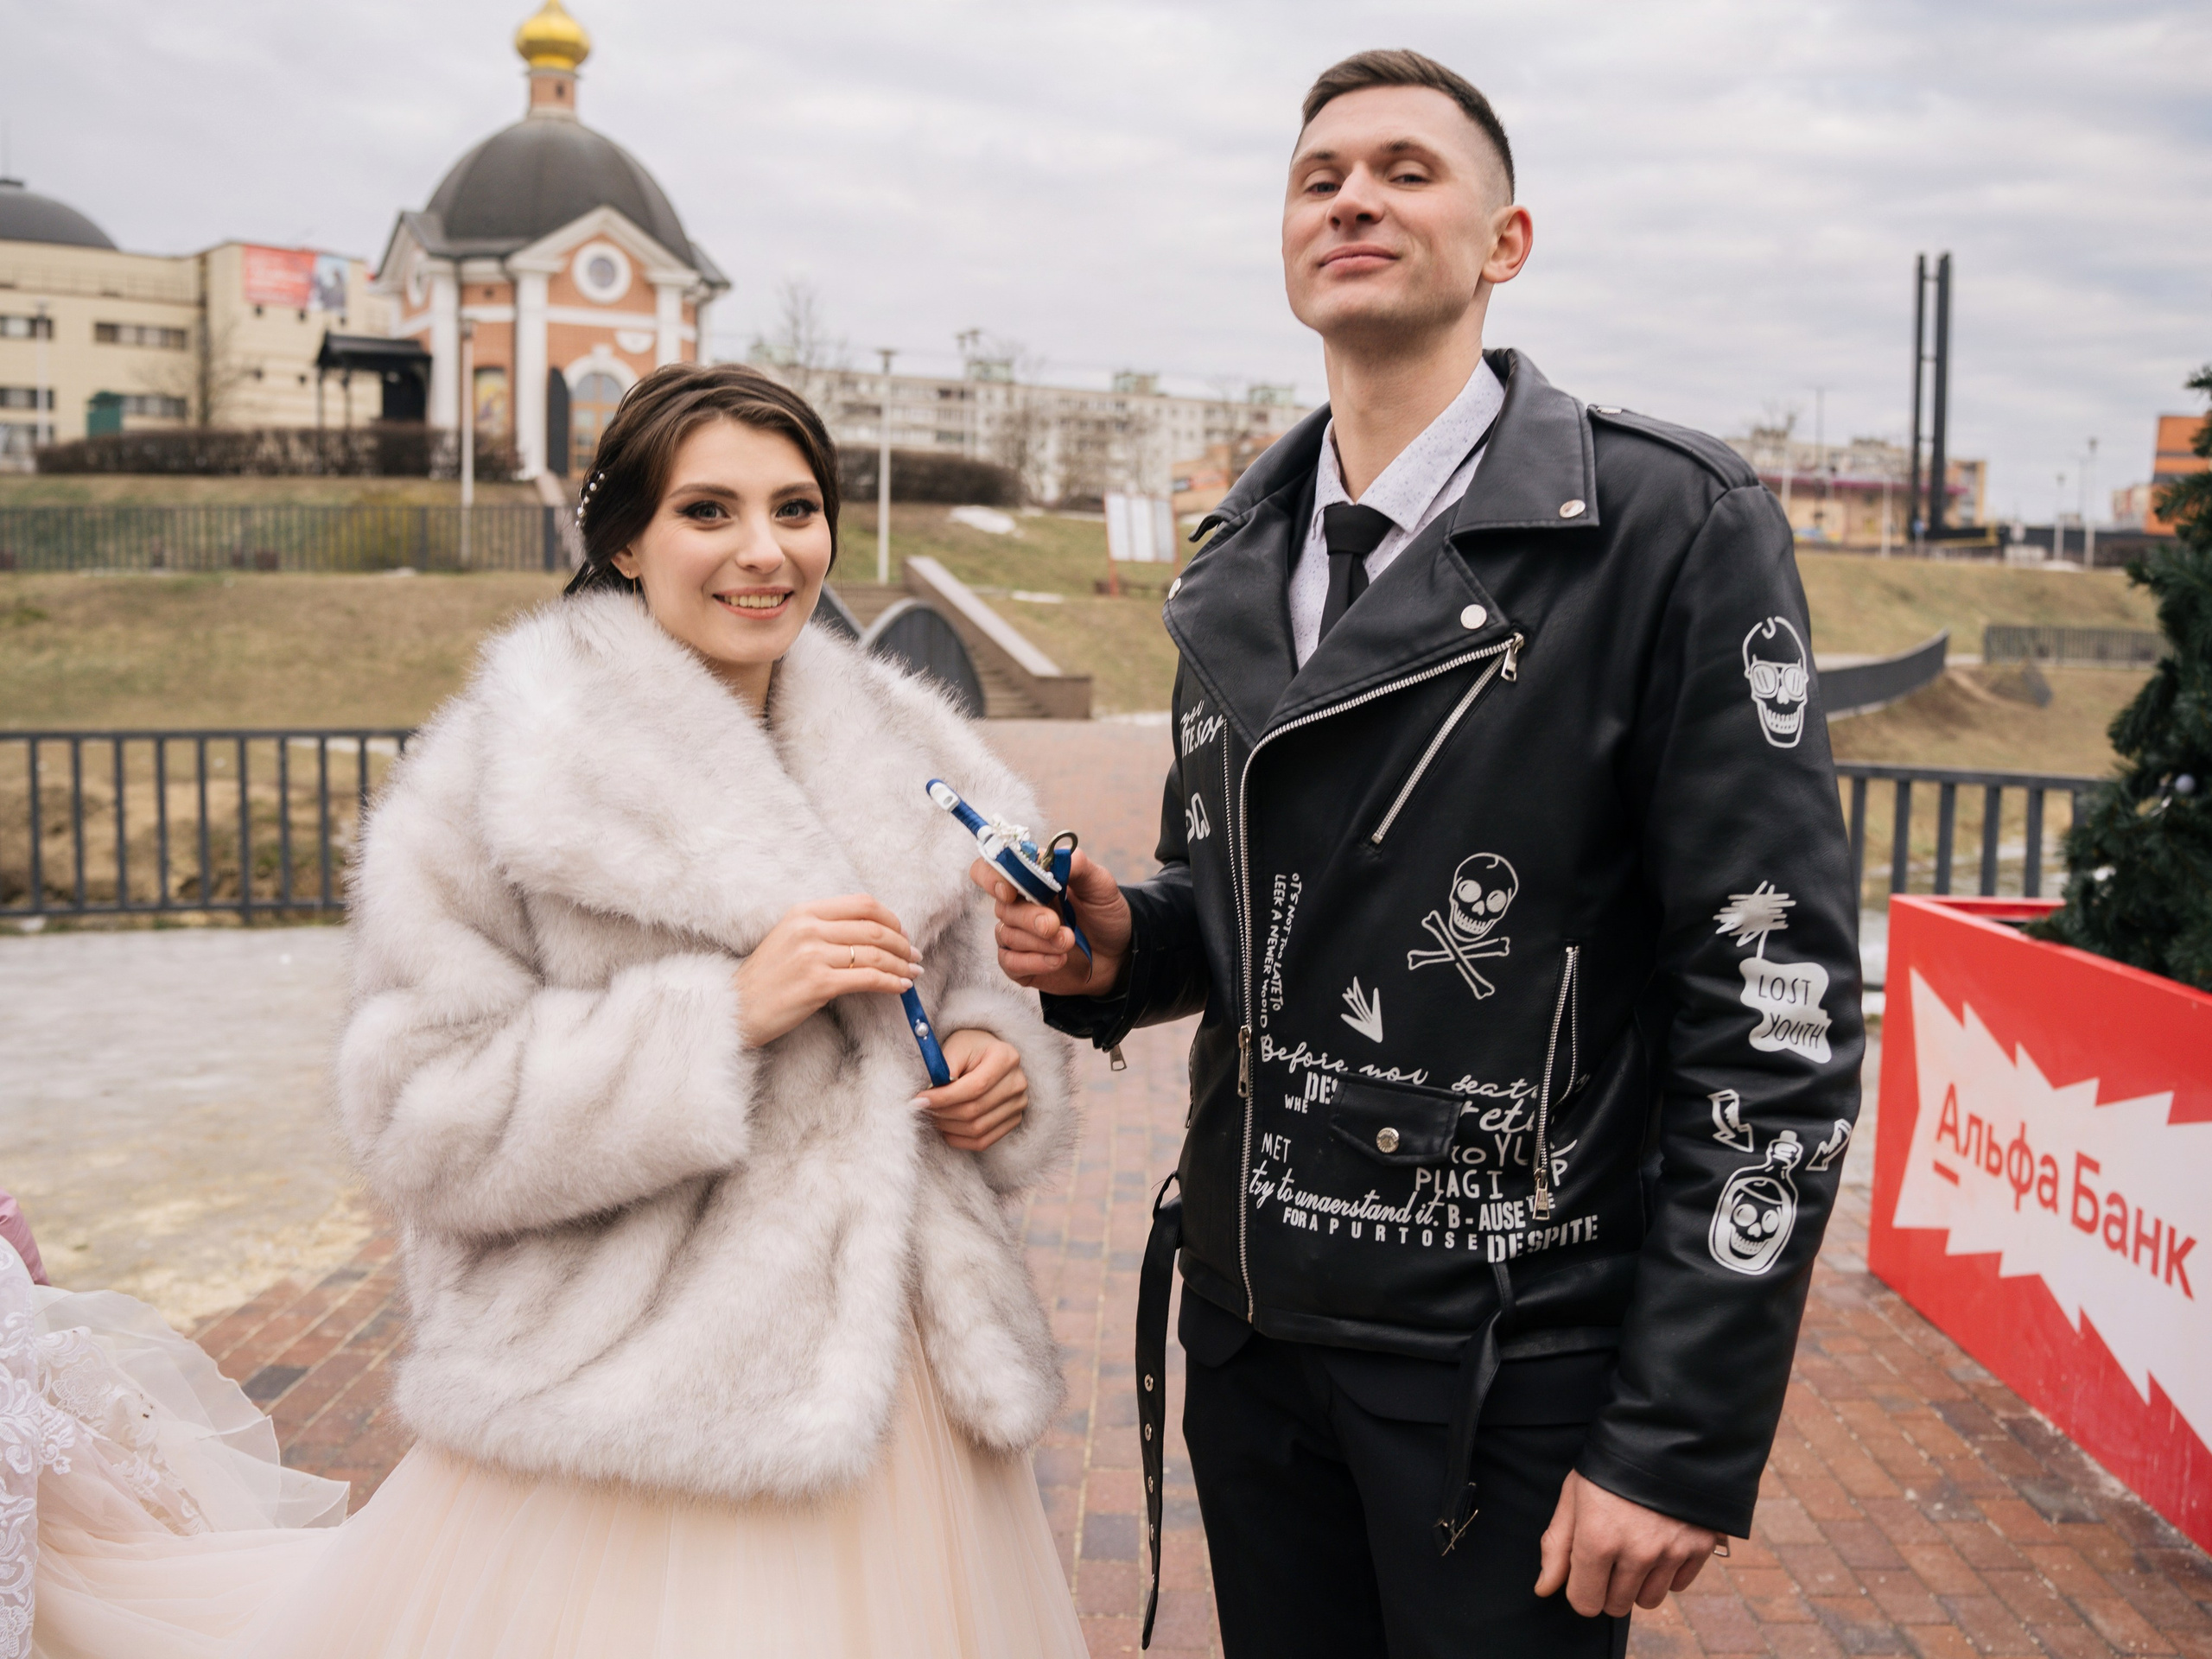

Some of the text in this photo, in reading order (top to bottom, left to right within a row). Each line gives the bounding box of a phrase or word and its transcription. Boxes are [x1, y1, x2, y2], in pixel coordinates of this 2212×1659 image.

[1274, 874, 1287, 907] LEEK
[1271, 908, 1282, 921] A
[1262, 925, 1280, 975] NEWER
[1271, 962, 1282, 998] LATE
[1758, 975, 1811, 1005] LOST
[1269, 995, 1284, 1012] TO
[1761, 1012, 1825, 1049] YOUTH
[1261, 1034, 1348, 1073] Before
[1285, 1093, 1309, 1115] WHE
[1262, 1132, 1292, 1164] MET
[1249, 1160, 1276, 1209] try
[1277, 1167, 1294, 1203] to
[1414, 1190, 1446, 1227] it.
[1525, 1192, 1556, 1212] TE
[1933, 1081, 2198, 1301] Альфа Банк
[1282, 1207, 1307, 1229] FOR
[1308, 1213, 1319, 1231] A
[1487, 1214, 1599, 1264] DESPITE
